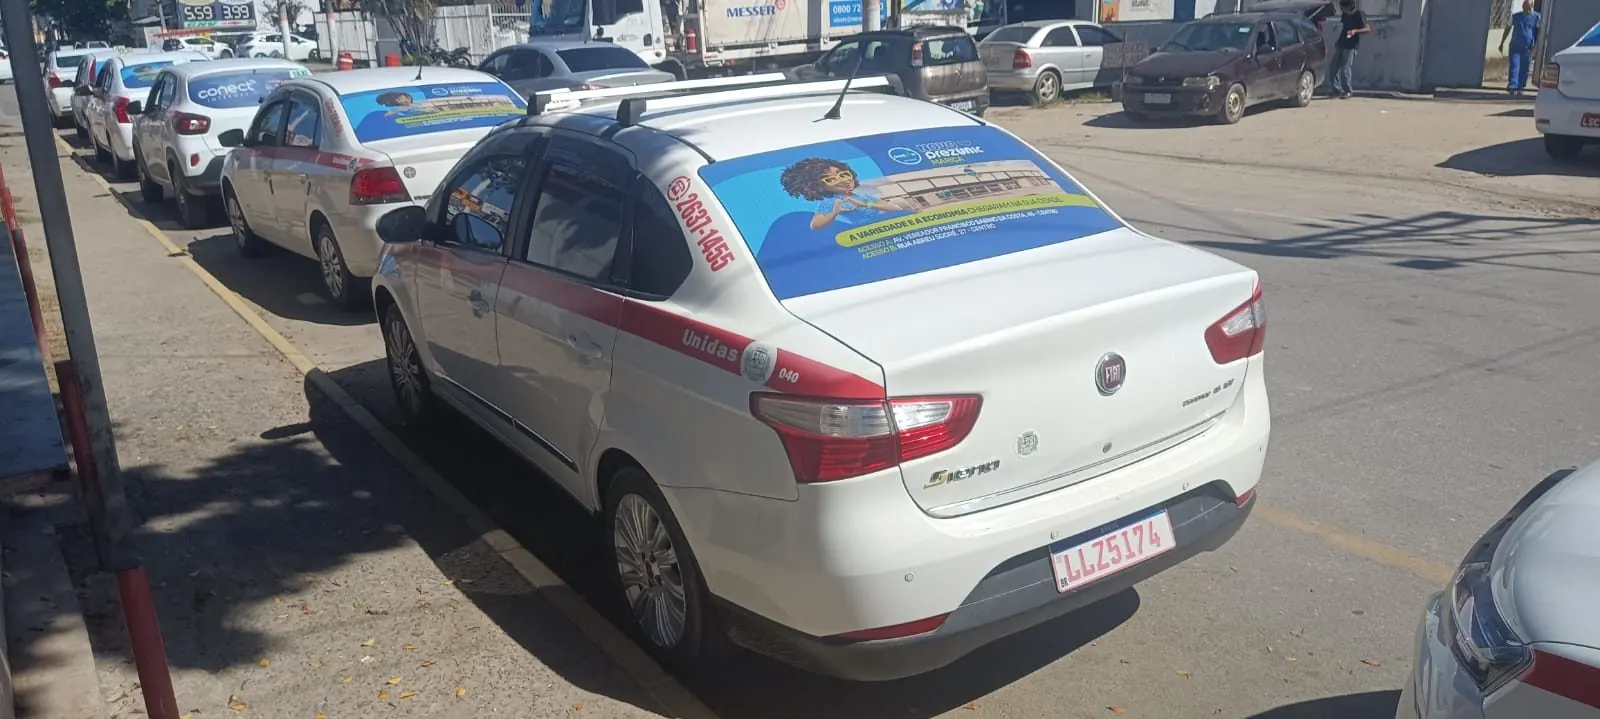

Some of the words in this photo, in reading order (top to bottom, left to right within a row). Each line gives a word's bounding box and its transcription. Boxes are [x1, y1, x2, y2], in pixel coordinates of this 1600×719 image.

[726, 6, 775, 18] MESSER
[833, 5, 850, 14] 0800
[676, 193, 735, 272] 2637-1455
[849, 233, 857, 242] A
[857, 220, 908, 239] VARIEDADE
[923, 208, 968, 222] ECONOMIA
[968, 202, 1011, 214] CHEGARAM
[1022, 198, 1037, 206] SUA
[904, 226, 940, 241] VEREADOR
[939, 219, 975, 233] FRANCISCO
[897, 241, 913, 250] RUA
[913, 235, 936, 246] ABREU
[971, 222, 996, 233] CENTRO
[682, 328, 739, 362] Unidas
[779, 367, 800, 384] 040
[1105, 364, 1121, 384] FIAT
[923, 460, 1000, 489] Siena
[1063, 520, 1161, 583] LLZ5174
[1060, 577, 1069, 588] BR
